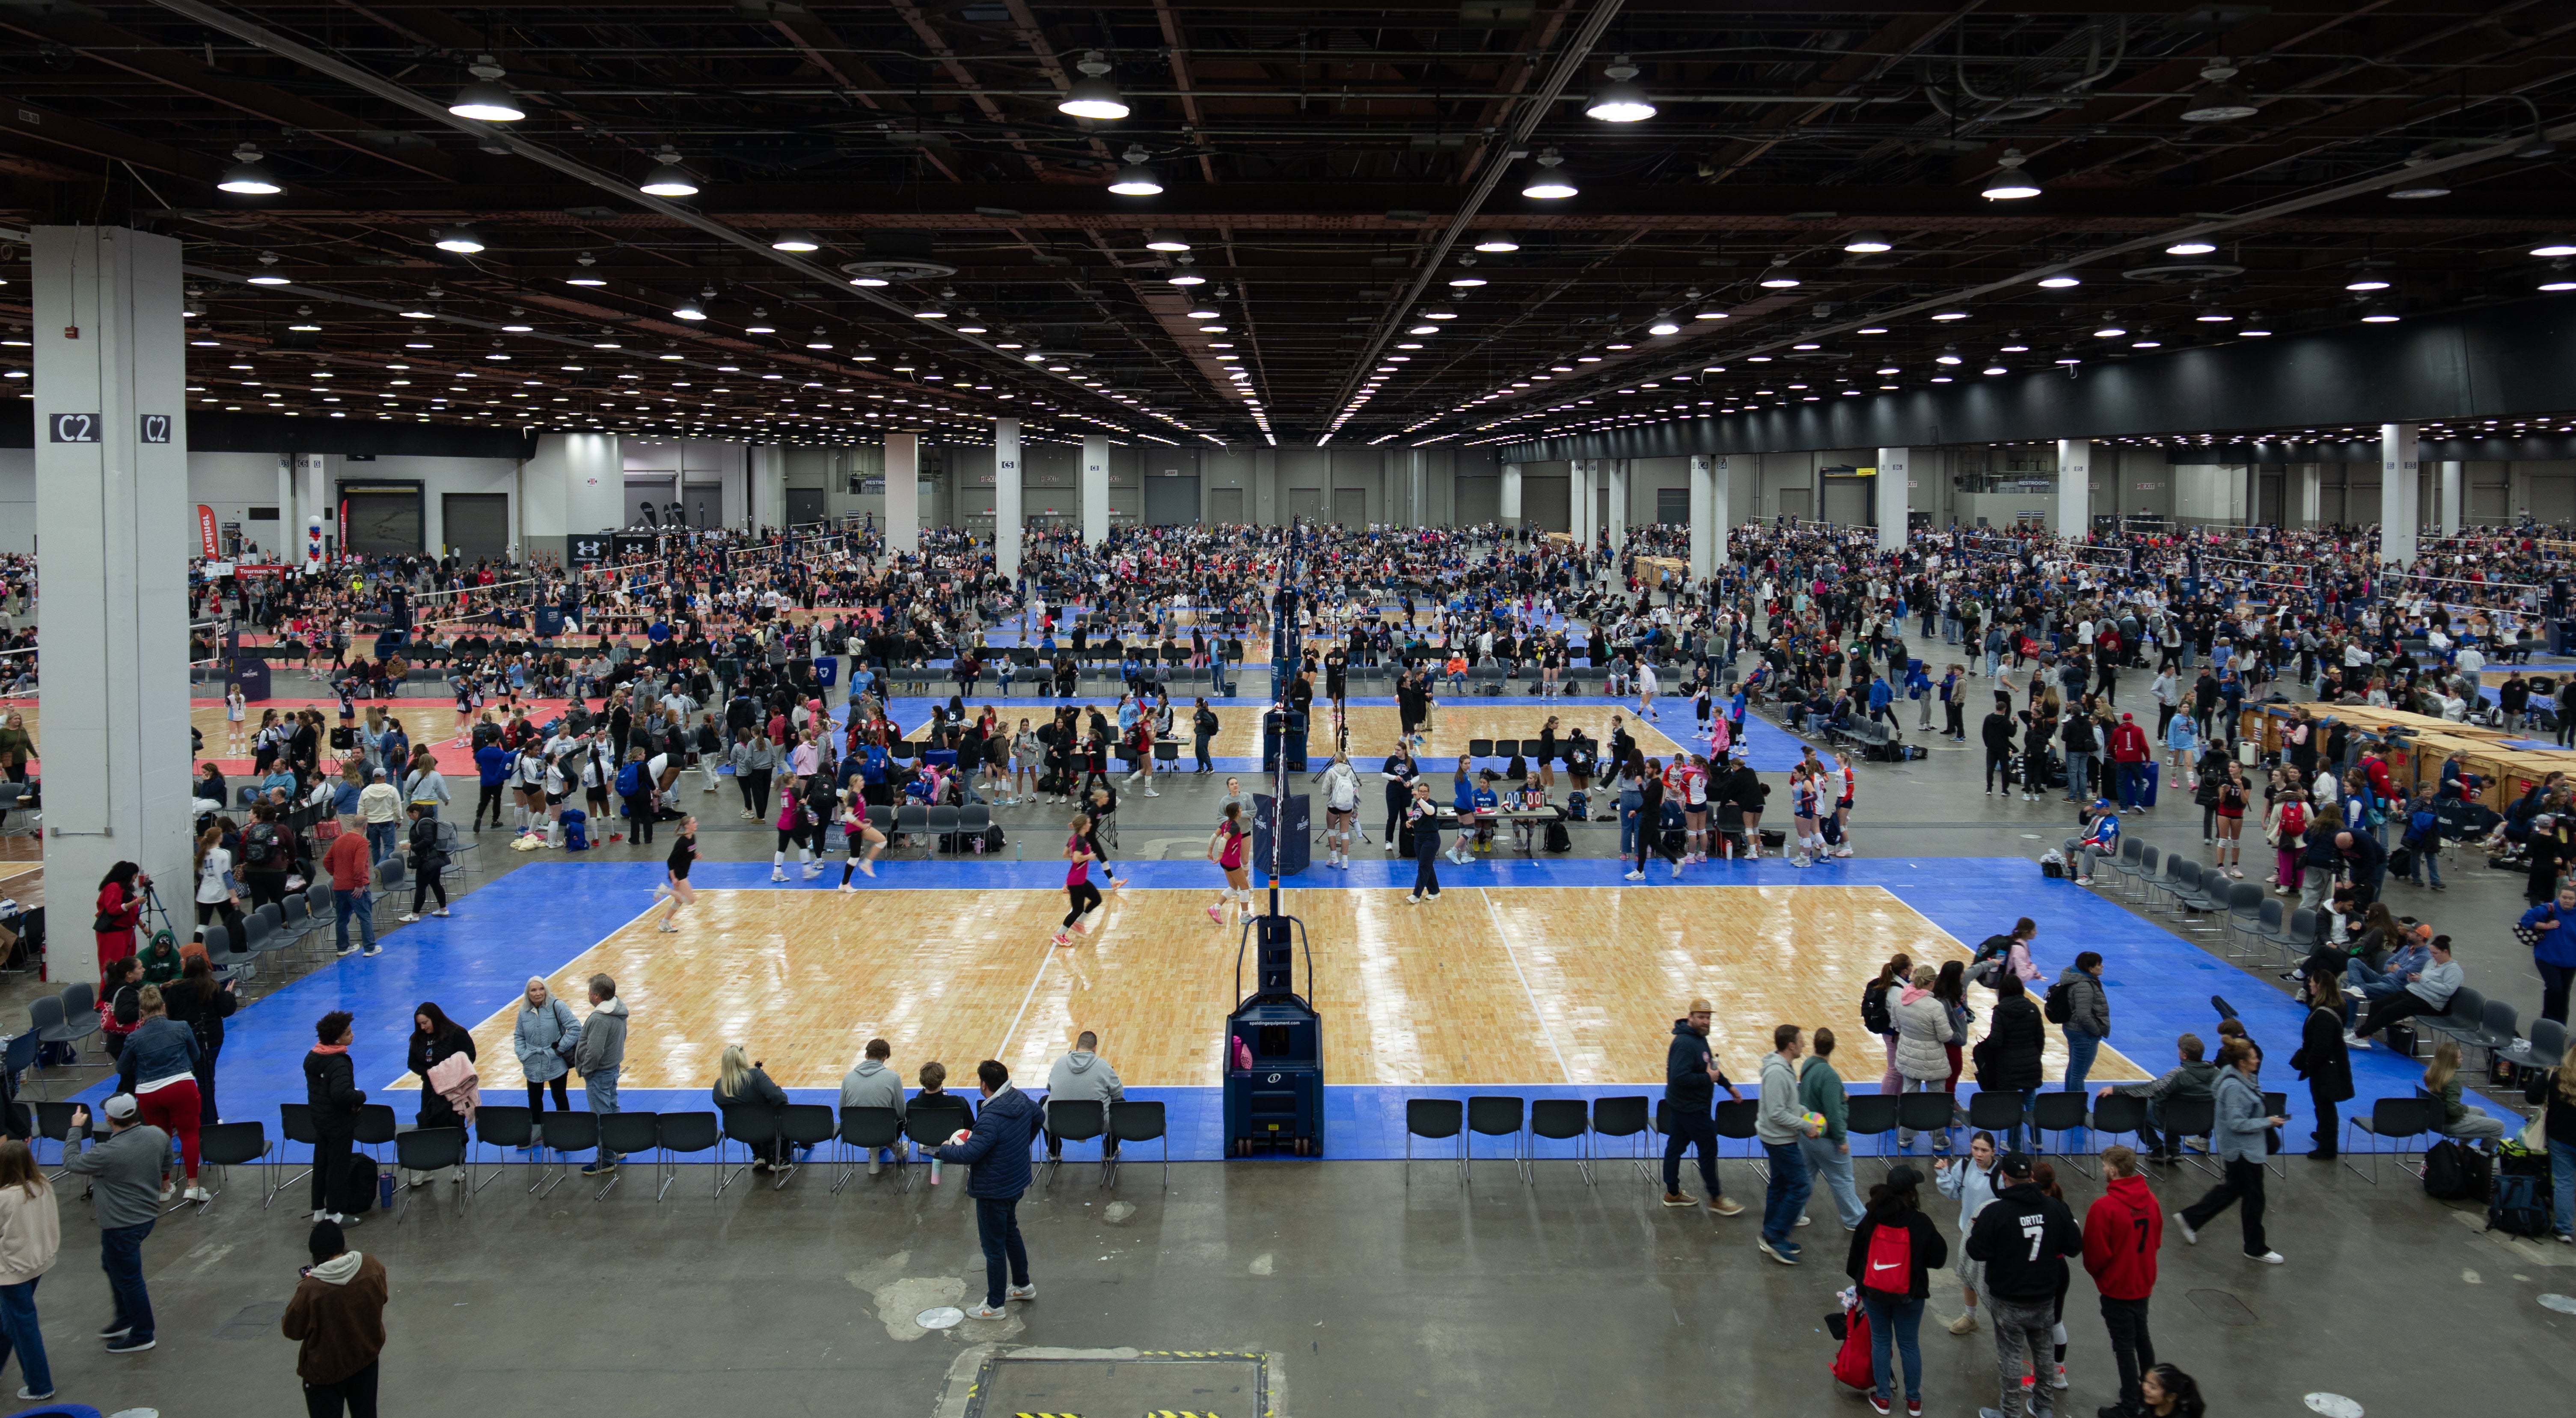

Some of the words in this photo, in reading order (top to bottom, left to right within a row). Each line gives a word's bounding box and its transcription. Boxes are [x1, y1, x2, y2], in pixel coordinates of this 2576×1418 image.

[59, 415, 91, 442] C2
[146, 415, 166, 442] C2
[202, 514, 215, 555] Trainer
[2540, 588, 2547, 597] 39
[407, 596, 413, 607] 21
[219, 623, 227, 635] 20
[237, 702, 241, 710] 7
[1699, 778, 1702, 788] 3
[1507, 792, 1519, 803] 00
[1527, 792, 1540, 804] 00
[2439, 816, 2452, 825] lten
[2020, 1214, 2044, 1227] ORTIZ
[2134, 1218, 2149, 1253] 7
[2023, 1226, 2043, 1261] 7
